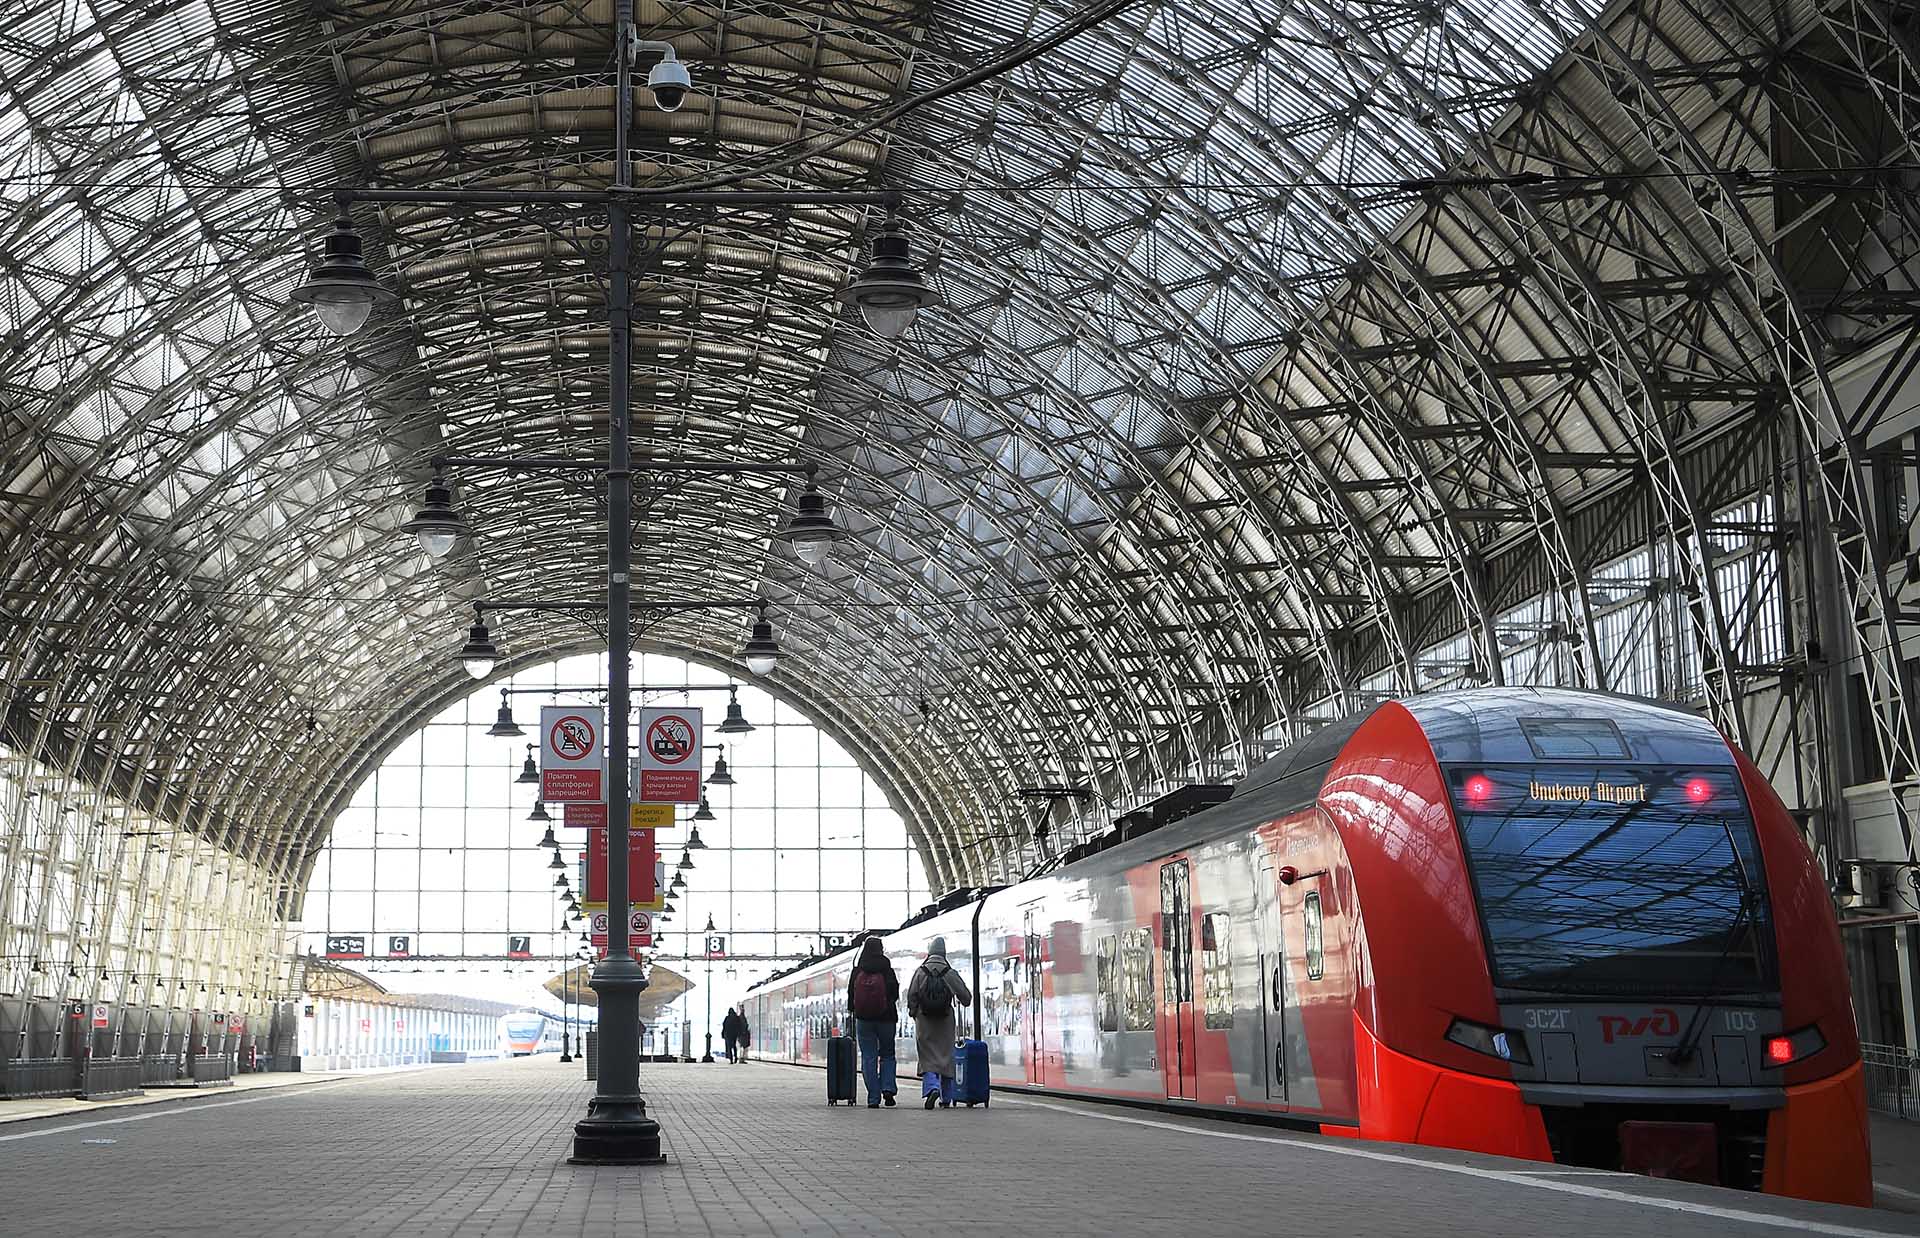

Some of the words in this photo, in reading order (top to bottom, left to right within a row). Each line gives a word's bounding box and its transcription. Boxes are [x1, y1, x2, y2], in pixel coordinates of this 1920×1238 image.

[547, 772, 577, 780] Прыгать
[552, 781, 593, 790] платформы
[547, 789, 590, 797] запрещено!
[1530, 782, 1590, 801] Vnukovo
[1597, 782, 1647, 804] Airport
[339, 939, 348, 952] 5
[393, 937, 404, 951] 6
[515, 937, 525, 952] 7
[709, 937, 721, 952] 8
[74, 1004, 82, 1014] 6
[1524, 1008, 1571, 1030] ЭС2Г
[1724, 1010, 1757, 1031] 103
